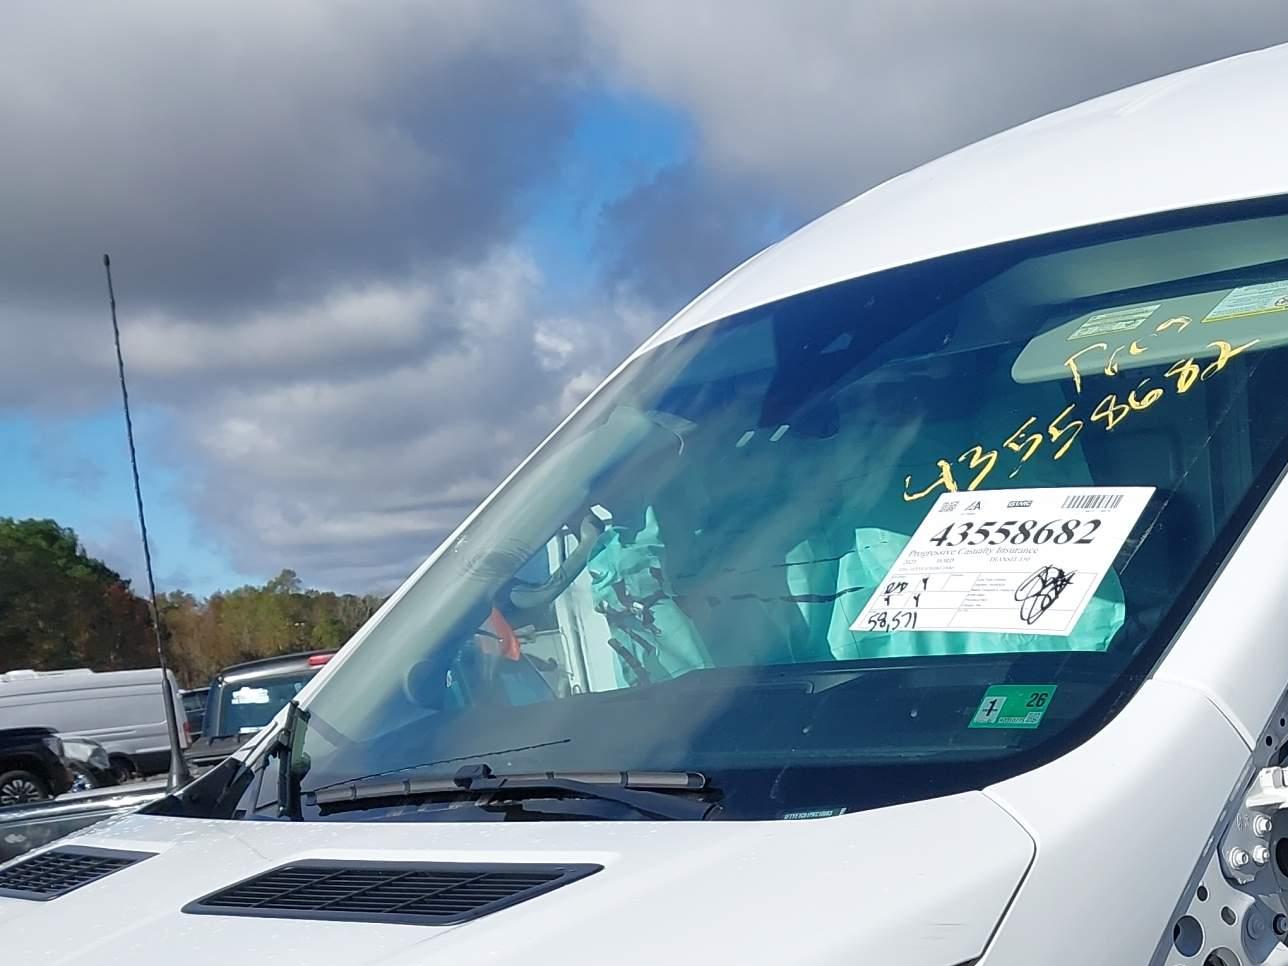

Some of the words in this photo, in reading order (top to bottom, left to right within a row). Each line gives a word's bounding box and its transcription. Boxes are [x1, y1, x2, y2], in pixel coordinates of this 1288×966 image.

[903, 337, 1262, 502] 43558682
[929, 518, 1102, 547] 43558682
[1025, 692, 1049, 708] 26
